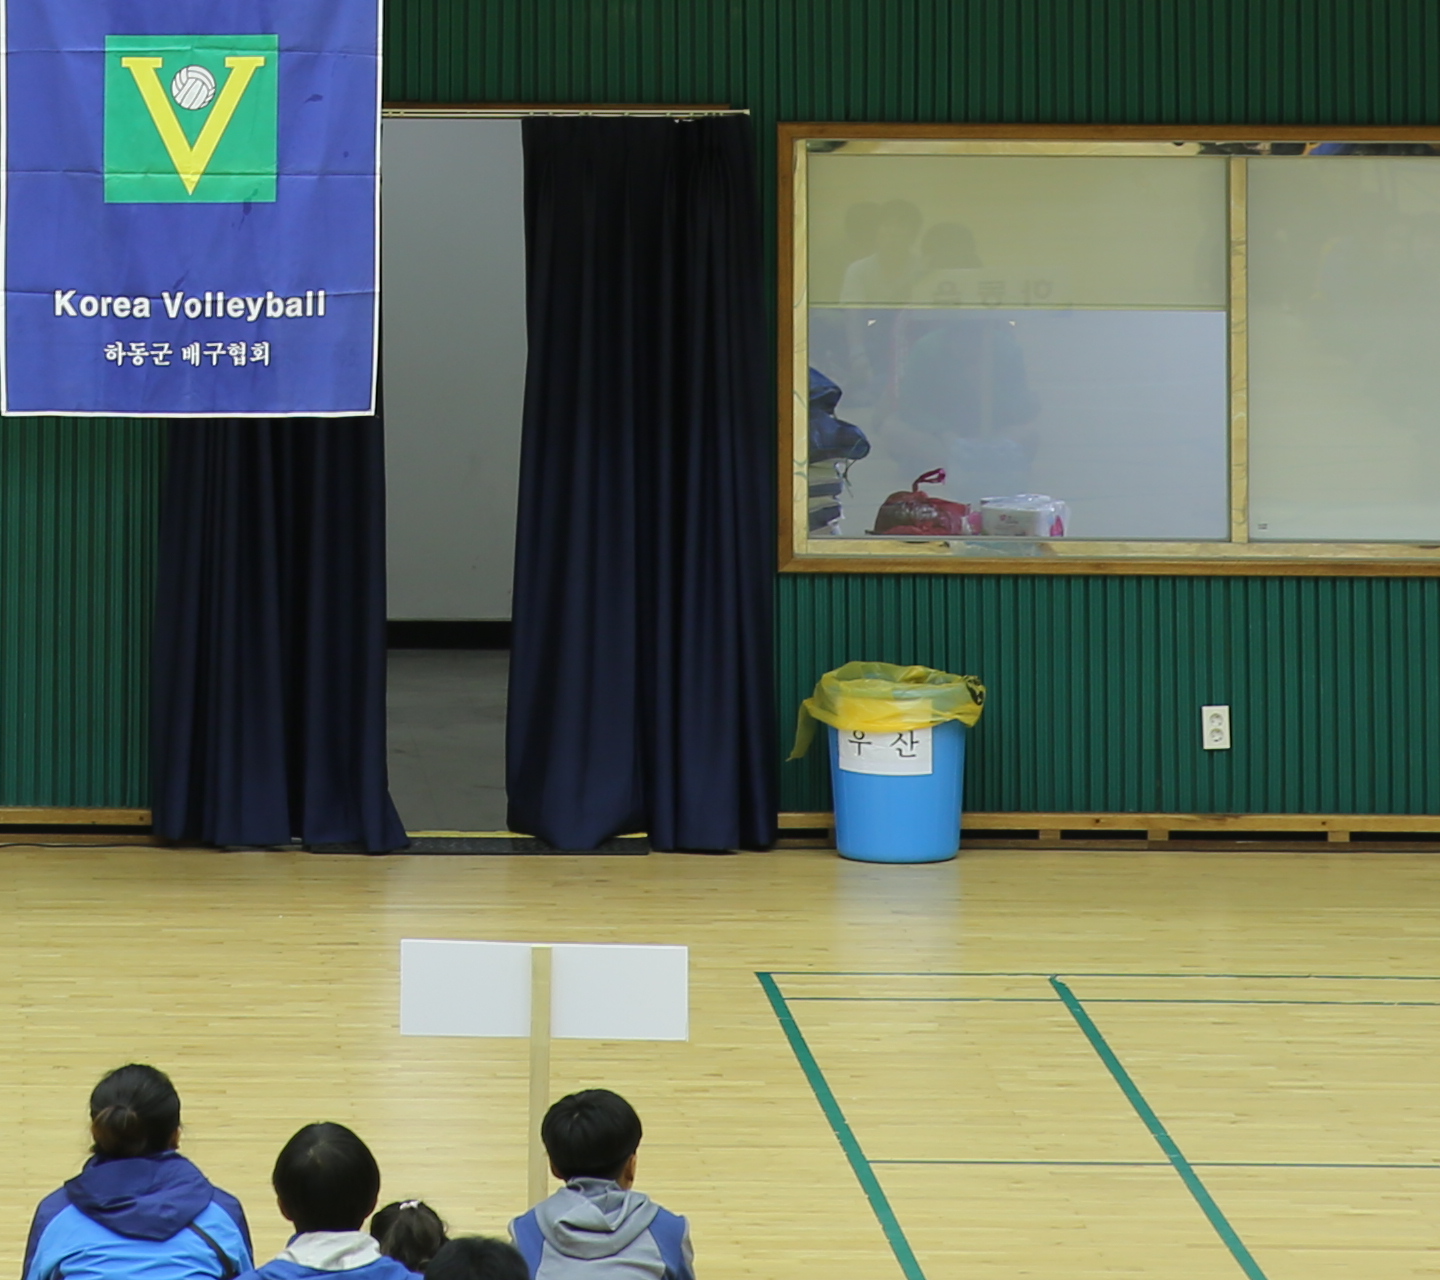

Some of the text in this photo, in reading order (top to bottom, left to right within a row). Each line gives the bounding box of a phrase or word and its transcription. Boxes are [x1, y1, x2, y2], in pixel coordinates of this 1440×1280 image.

[122, 56, 265, 196] V
[54, 290, 326, 321] Korea Volleyball
[103, 342, 271, 367] 하동군 배구협회
[888, 731, 920, 759] 산
